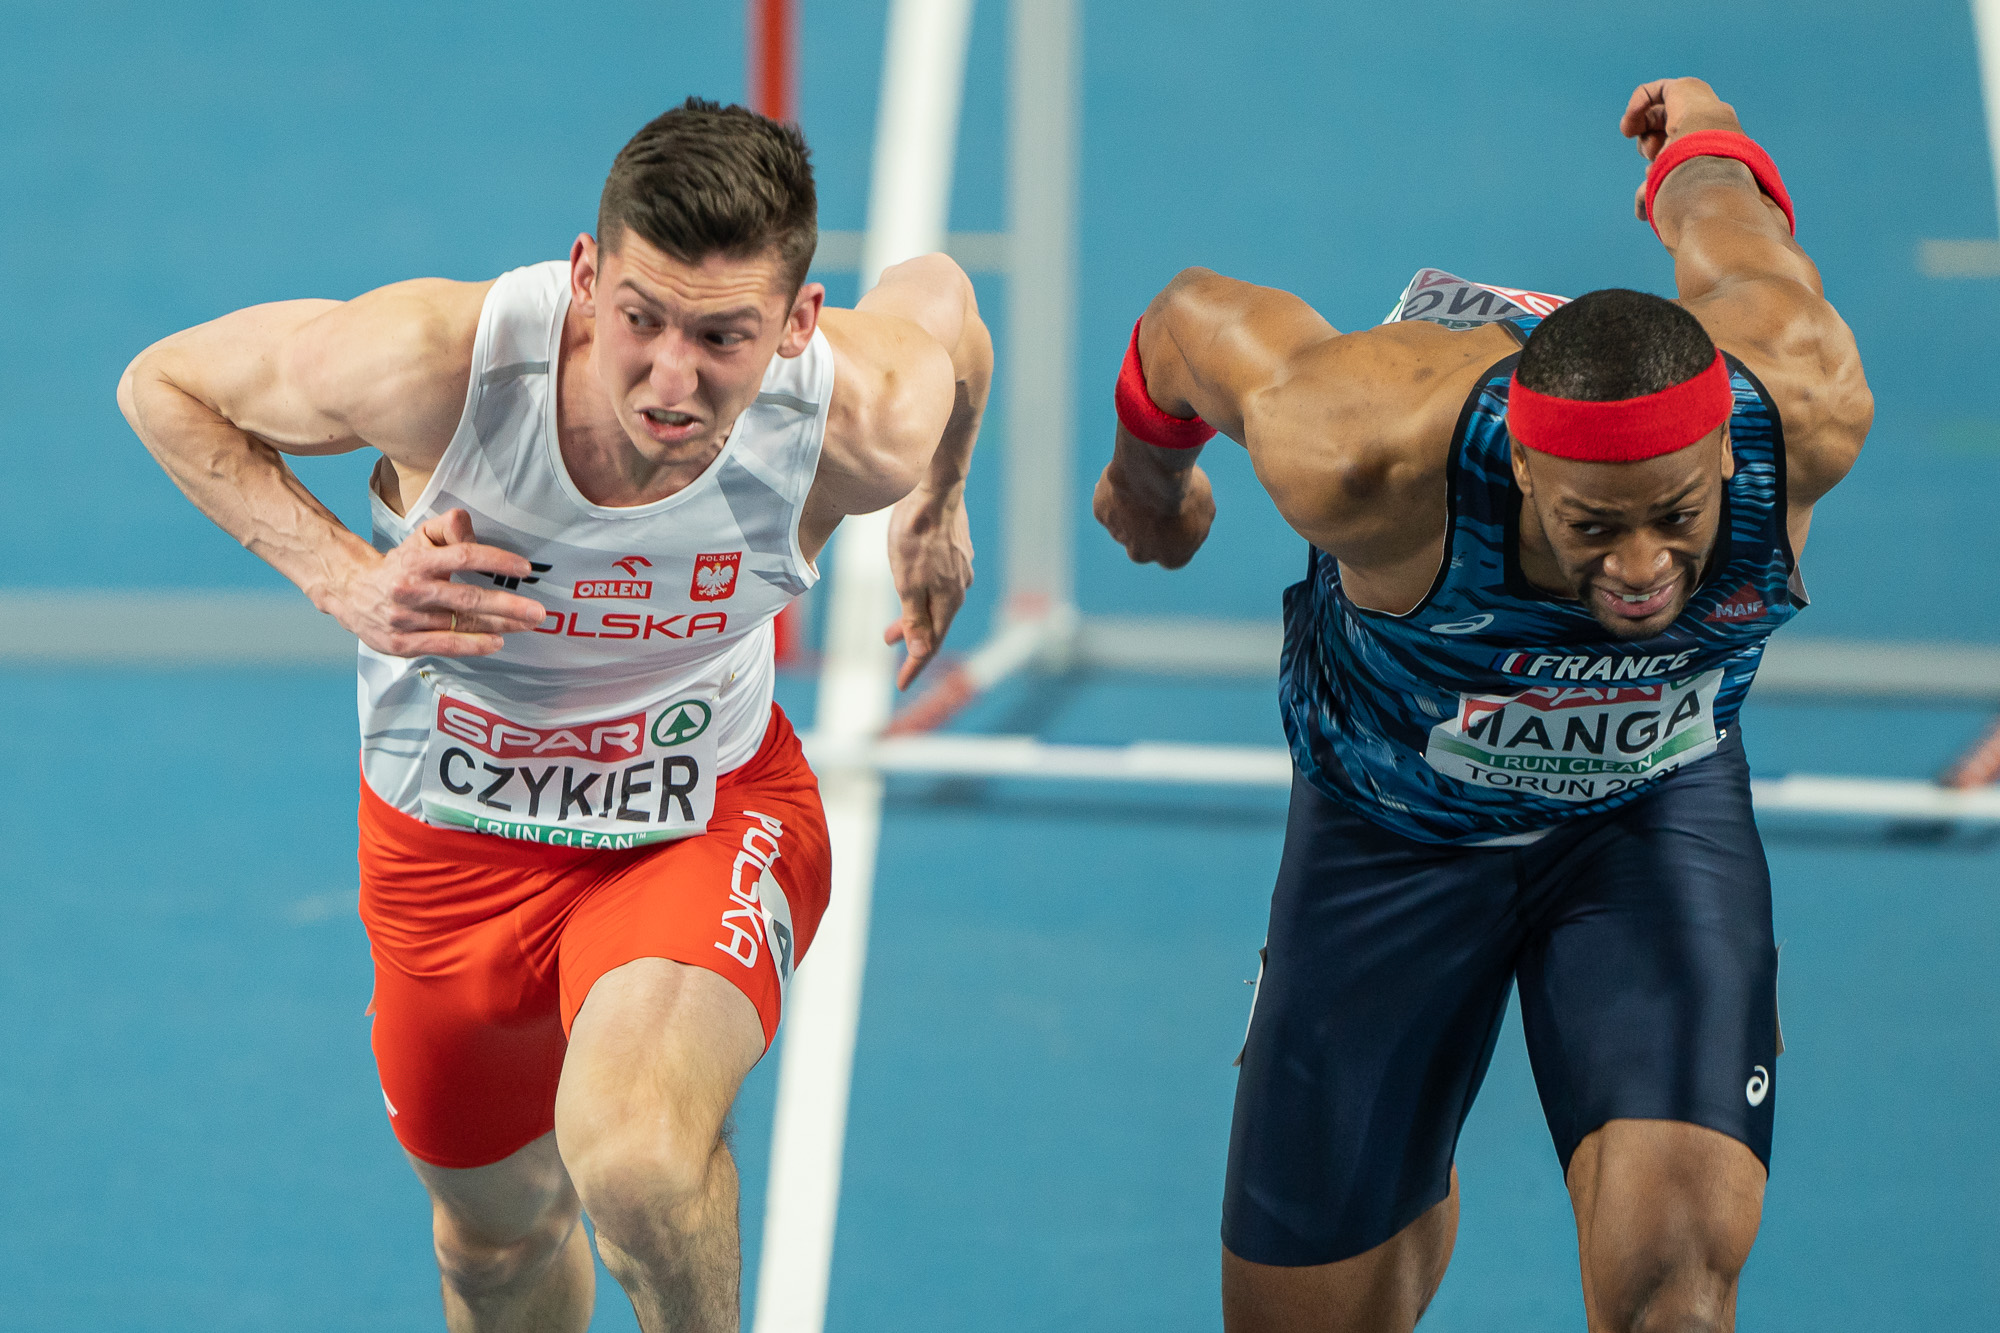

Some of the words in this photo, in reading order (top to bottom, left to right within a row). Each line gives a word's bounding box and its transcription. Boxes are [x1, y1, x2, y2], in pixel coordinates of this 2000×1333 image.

[699, 554, 738, 562] POLSKA
[577, 582, 648, 598] ORLEN
[1715, 600, 1763, 618] MAIF
[532, 611, 728, 640] OLSKA
[1527, 648, 1700, 681] FRANCE
[443, 706, 640, 754] SPAR
[1489, 755, 1495, 766] I
[1504, 756, 1560, 773] RUN
[439, 746, 699, 823] CZYKIER
[1465, 763, 1595, 797] TORUŃ
